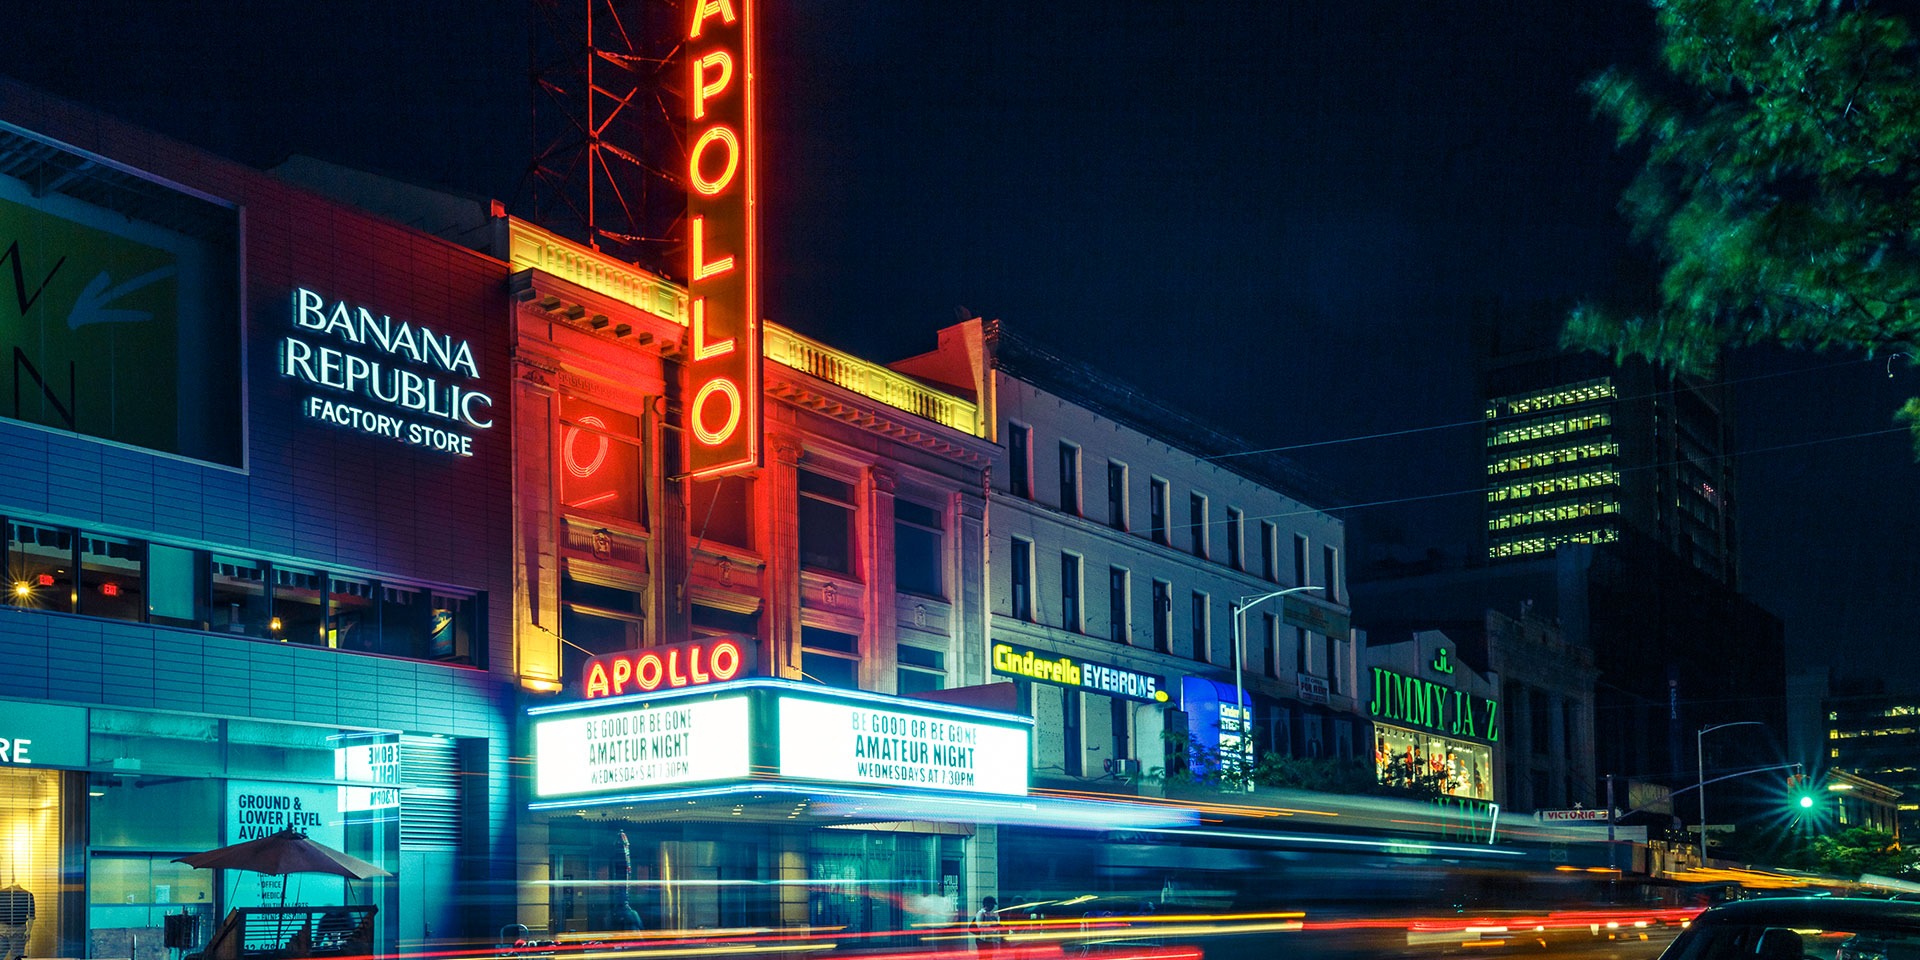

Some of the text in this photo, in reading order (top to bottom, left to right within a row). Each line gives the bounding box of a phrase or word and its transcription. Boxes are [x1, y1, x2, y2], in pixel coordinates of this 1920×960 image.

[688, 0, 742, 446] APOLLO
[296, 287, 480, 380] BANANA
[285, 337, 493, 430] REPUBLIC
[310, 396, 474, 457] FACTORY STORE
[586, 642, 740, 699] APOLLO
[993, 643, 1156, 699] Cinderella EYEBROWS
[1220, 703, 1250, 720] Cinderla
[1371, 667, 1498, 742] JIMMY JAZ
[586, 709, 692, 740] BE GOOD OR BE GONE
[852, 711, 977, 745] BE GOOD OR BE GONE
[589, 732, 689, 766] AMATEUR NIGHT
[855, 734, 975, 769] AMATEUR NIGHT
[646, 764, 656, 779] AT
[659, 761, 689, 778] 730PM
[857, 761, 925, 783] WEDNESDAYS
[928, 768, 939, 783] AT
[238, 794, 302, 810] GROUND &
[239, 810, 322, 826] LOWER LEVEL
[1547, 810, 1596, 820] VICTORIA
[238, 825, 308, 840] AVAILE
[261, 881, 282, 889] OFFICE
